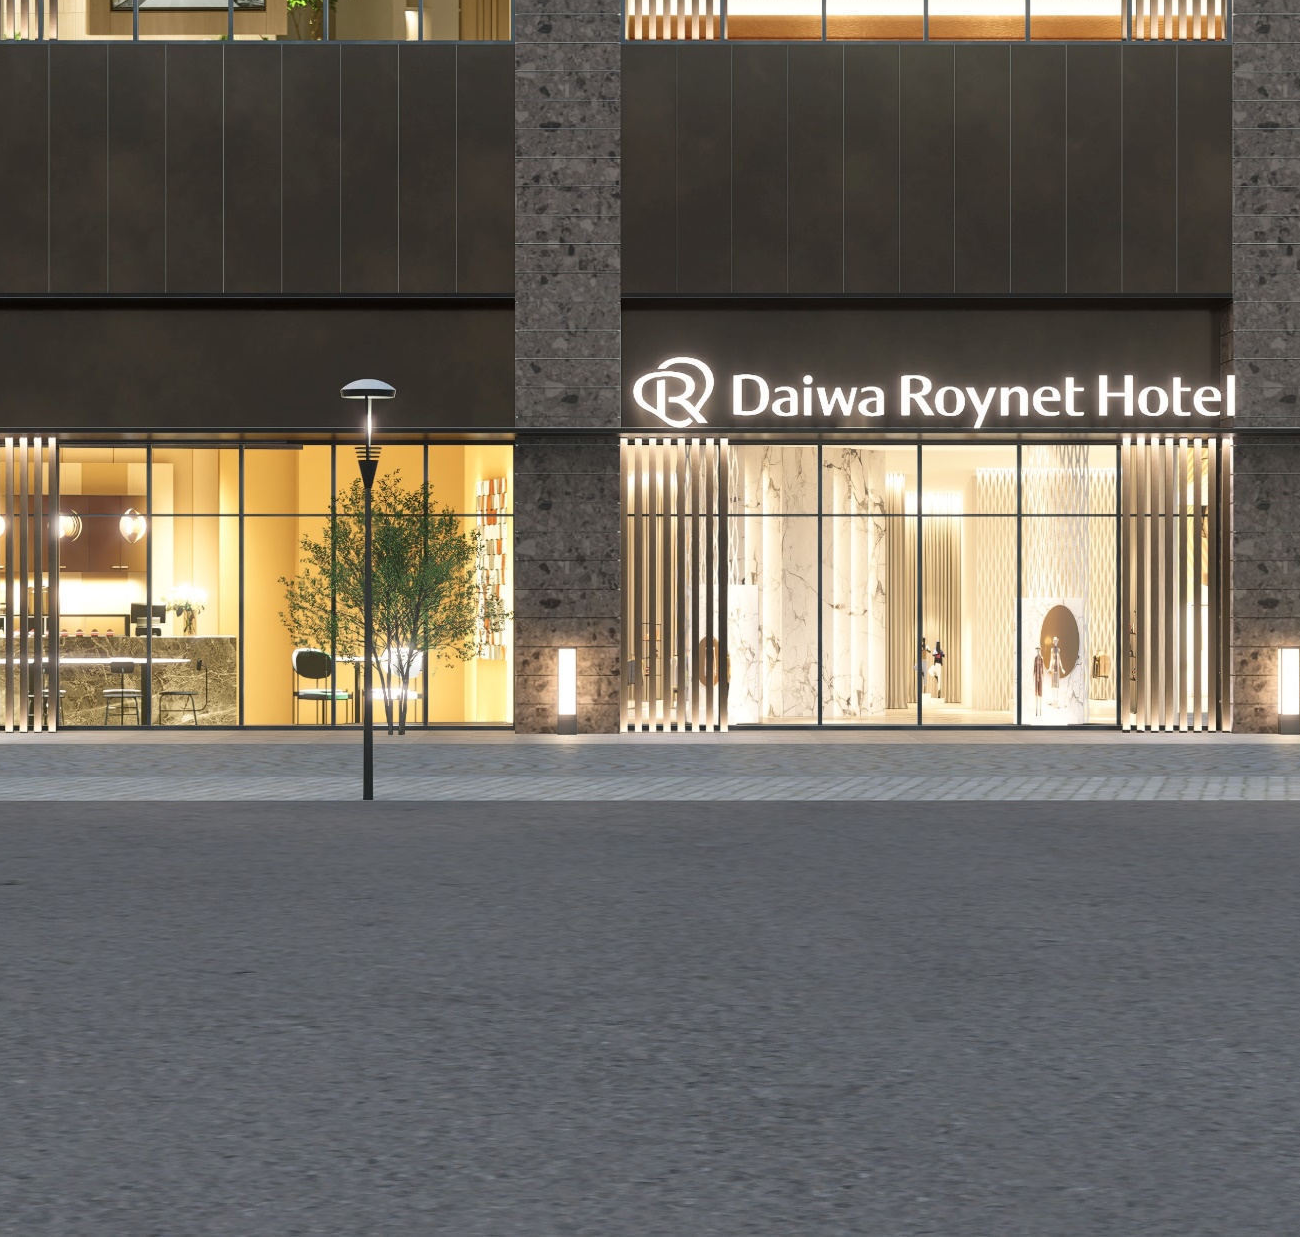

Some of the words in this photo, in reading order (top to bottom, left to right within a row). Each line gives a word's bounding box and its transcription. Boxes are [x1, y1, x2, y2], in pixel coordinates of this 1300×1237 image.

[732, 373, 885, 417] Daiwa
[900, 374, 1085, 429] Roynet
[1098, 374, 1236, 417] Hotel
